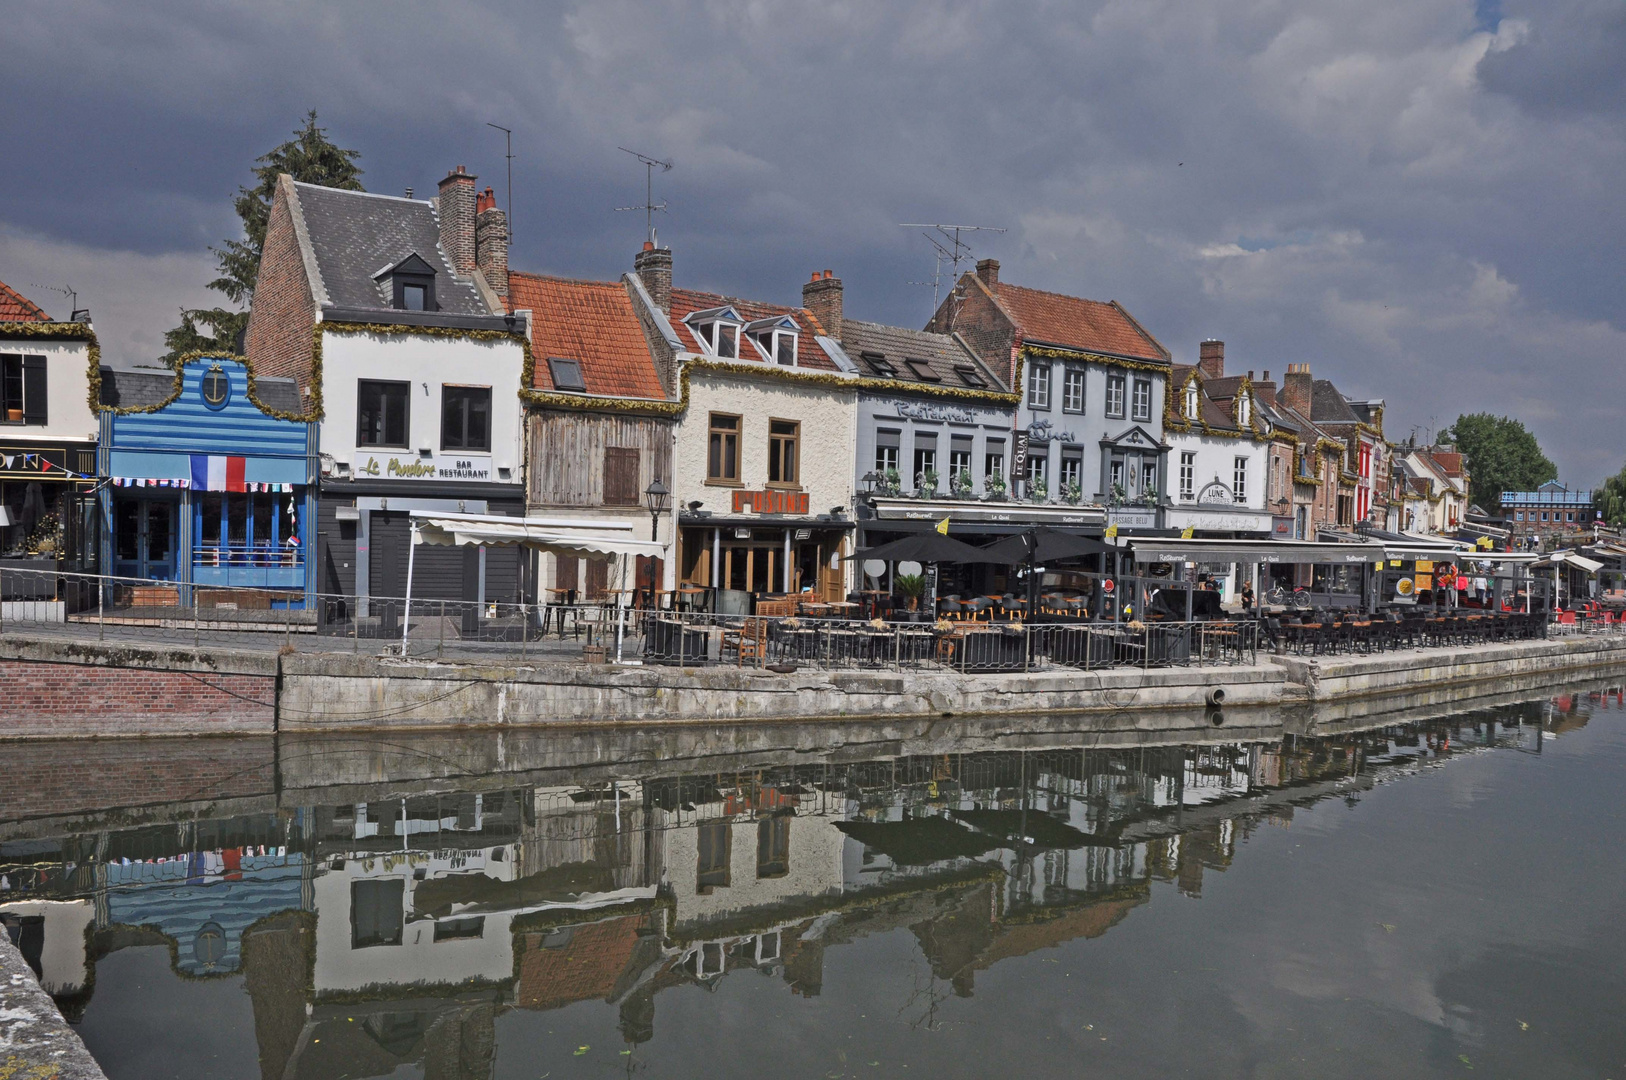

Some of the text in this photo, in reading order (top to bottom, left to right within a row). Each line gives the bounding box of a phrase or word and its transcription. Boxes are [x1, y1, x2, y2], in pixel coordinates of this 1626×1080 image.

[1027, 422, 1075, 442] Quai
[1016, 435, 1027, 463] QUAI
[359, 456, 436, 477] Le Pandore
[456, 461, 472, 469] BAR
[1016, 465, 1024, 475] LE
[439, 469, 488, 479] RESTAURANT
[1208, 489, 1224, 498] LUNE
[735, 491, 807, 513] L'USINE
[1112, 516, 1133, 524] PASSAGE
